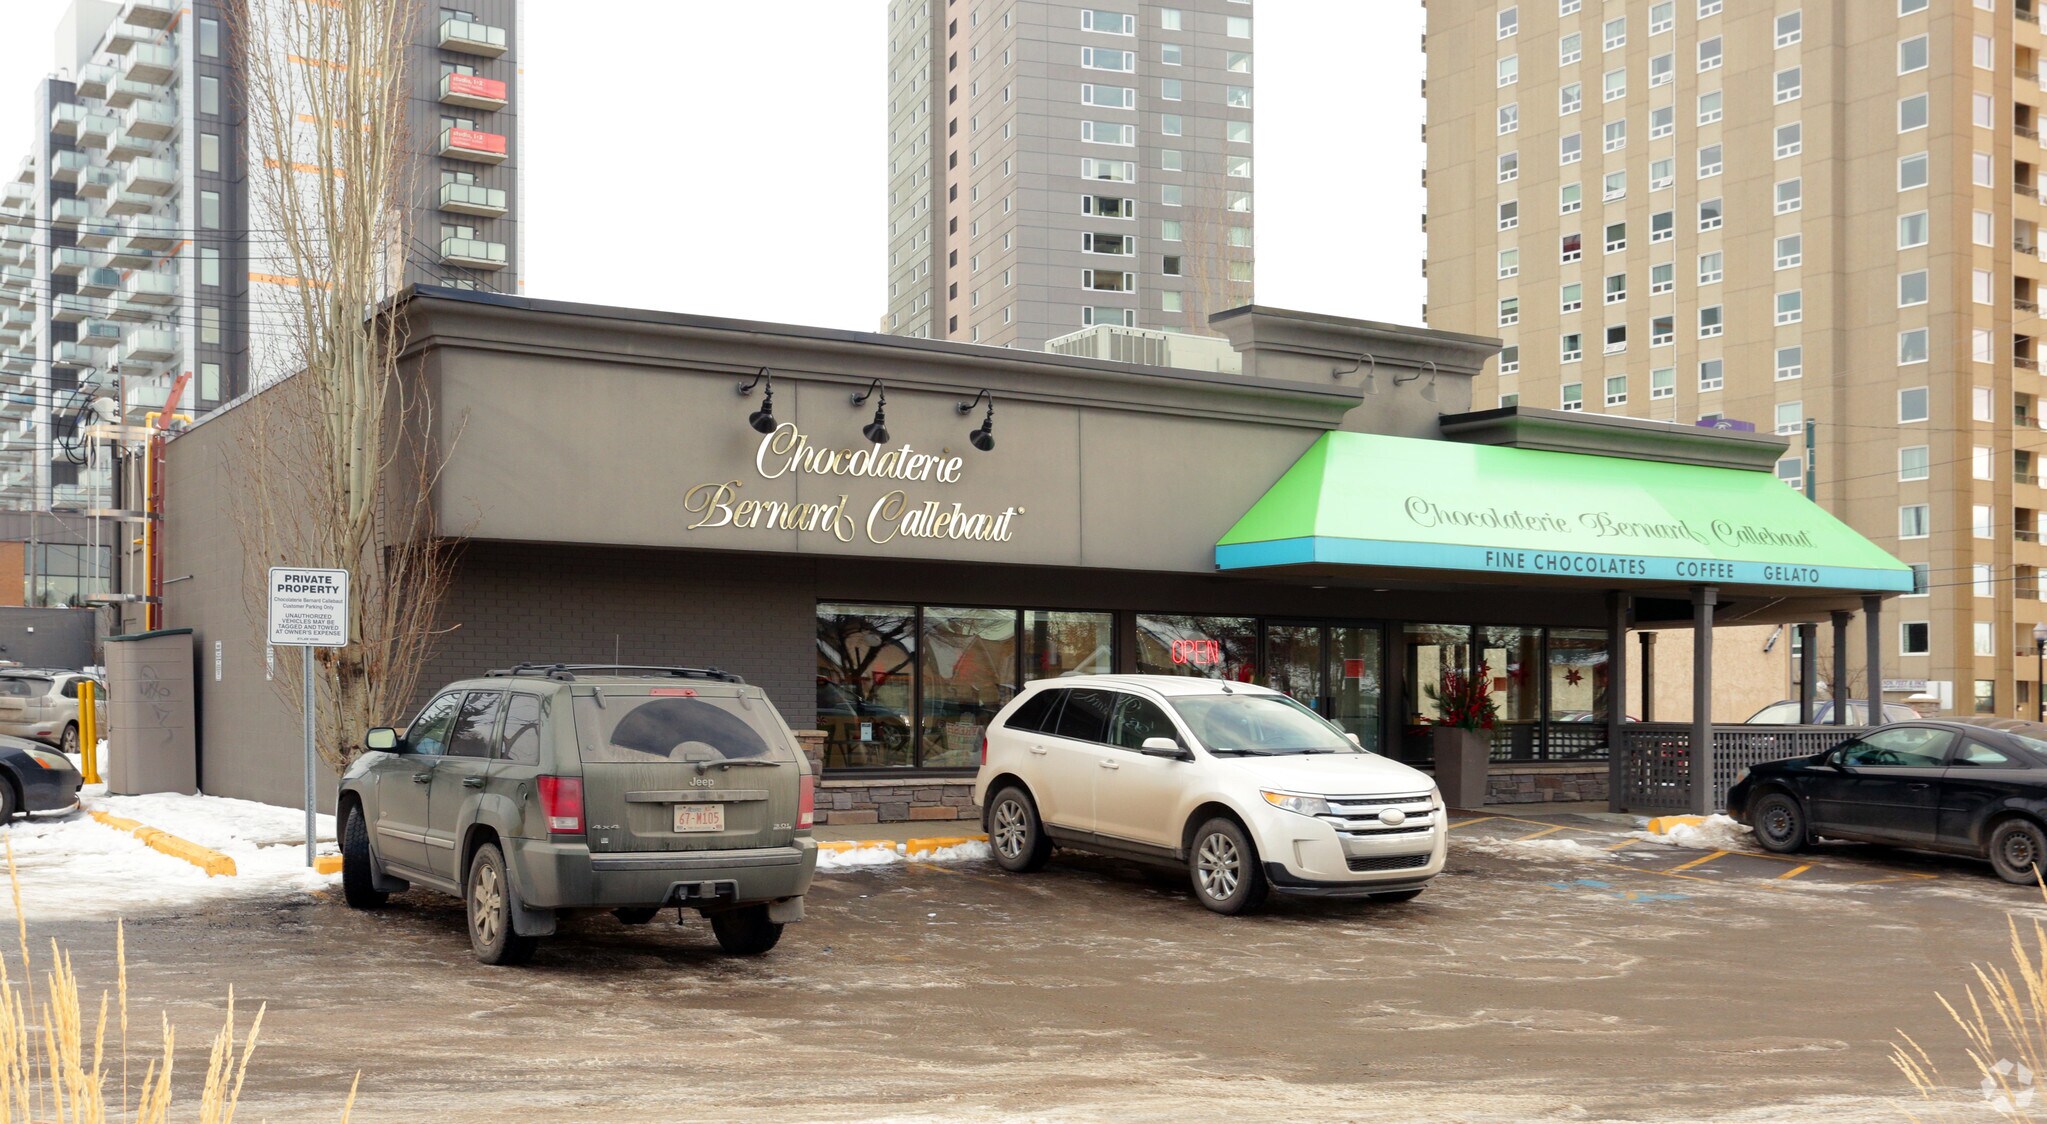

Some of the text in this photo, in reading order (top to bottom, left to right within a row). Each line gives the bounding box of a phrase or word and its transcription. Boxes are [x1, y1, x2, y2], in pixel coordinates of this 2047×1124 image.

[756, 422, 963, 483] Chocolaterie
[684, 479, 855, 542] Bernard
[1404, 495, 1815, 549] Chocolaterie Bernard Callebaut
[284, 574, 333, 585] PRIVATE
[1486, 551, 1820, 583] FINE CHOCOLATES COFFEE GELATO
[277, 584, 340, 594] PROPERTY
[1172, 640, 1219, 664] OPEN
[689, 776, 715, 788] Jeep
